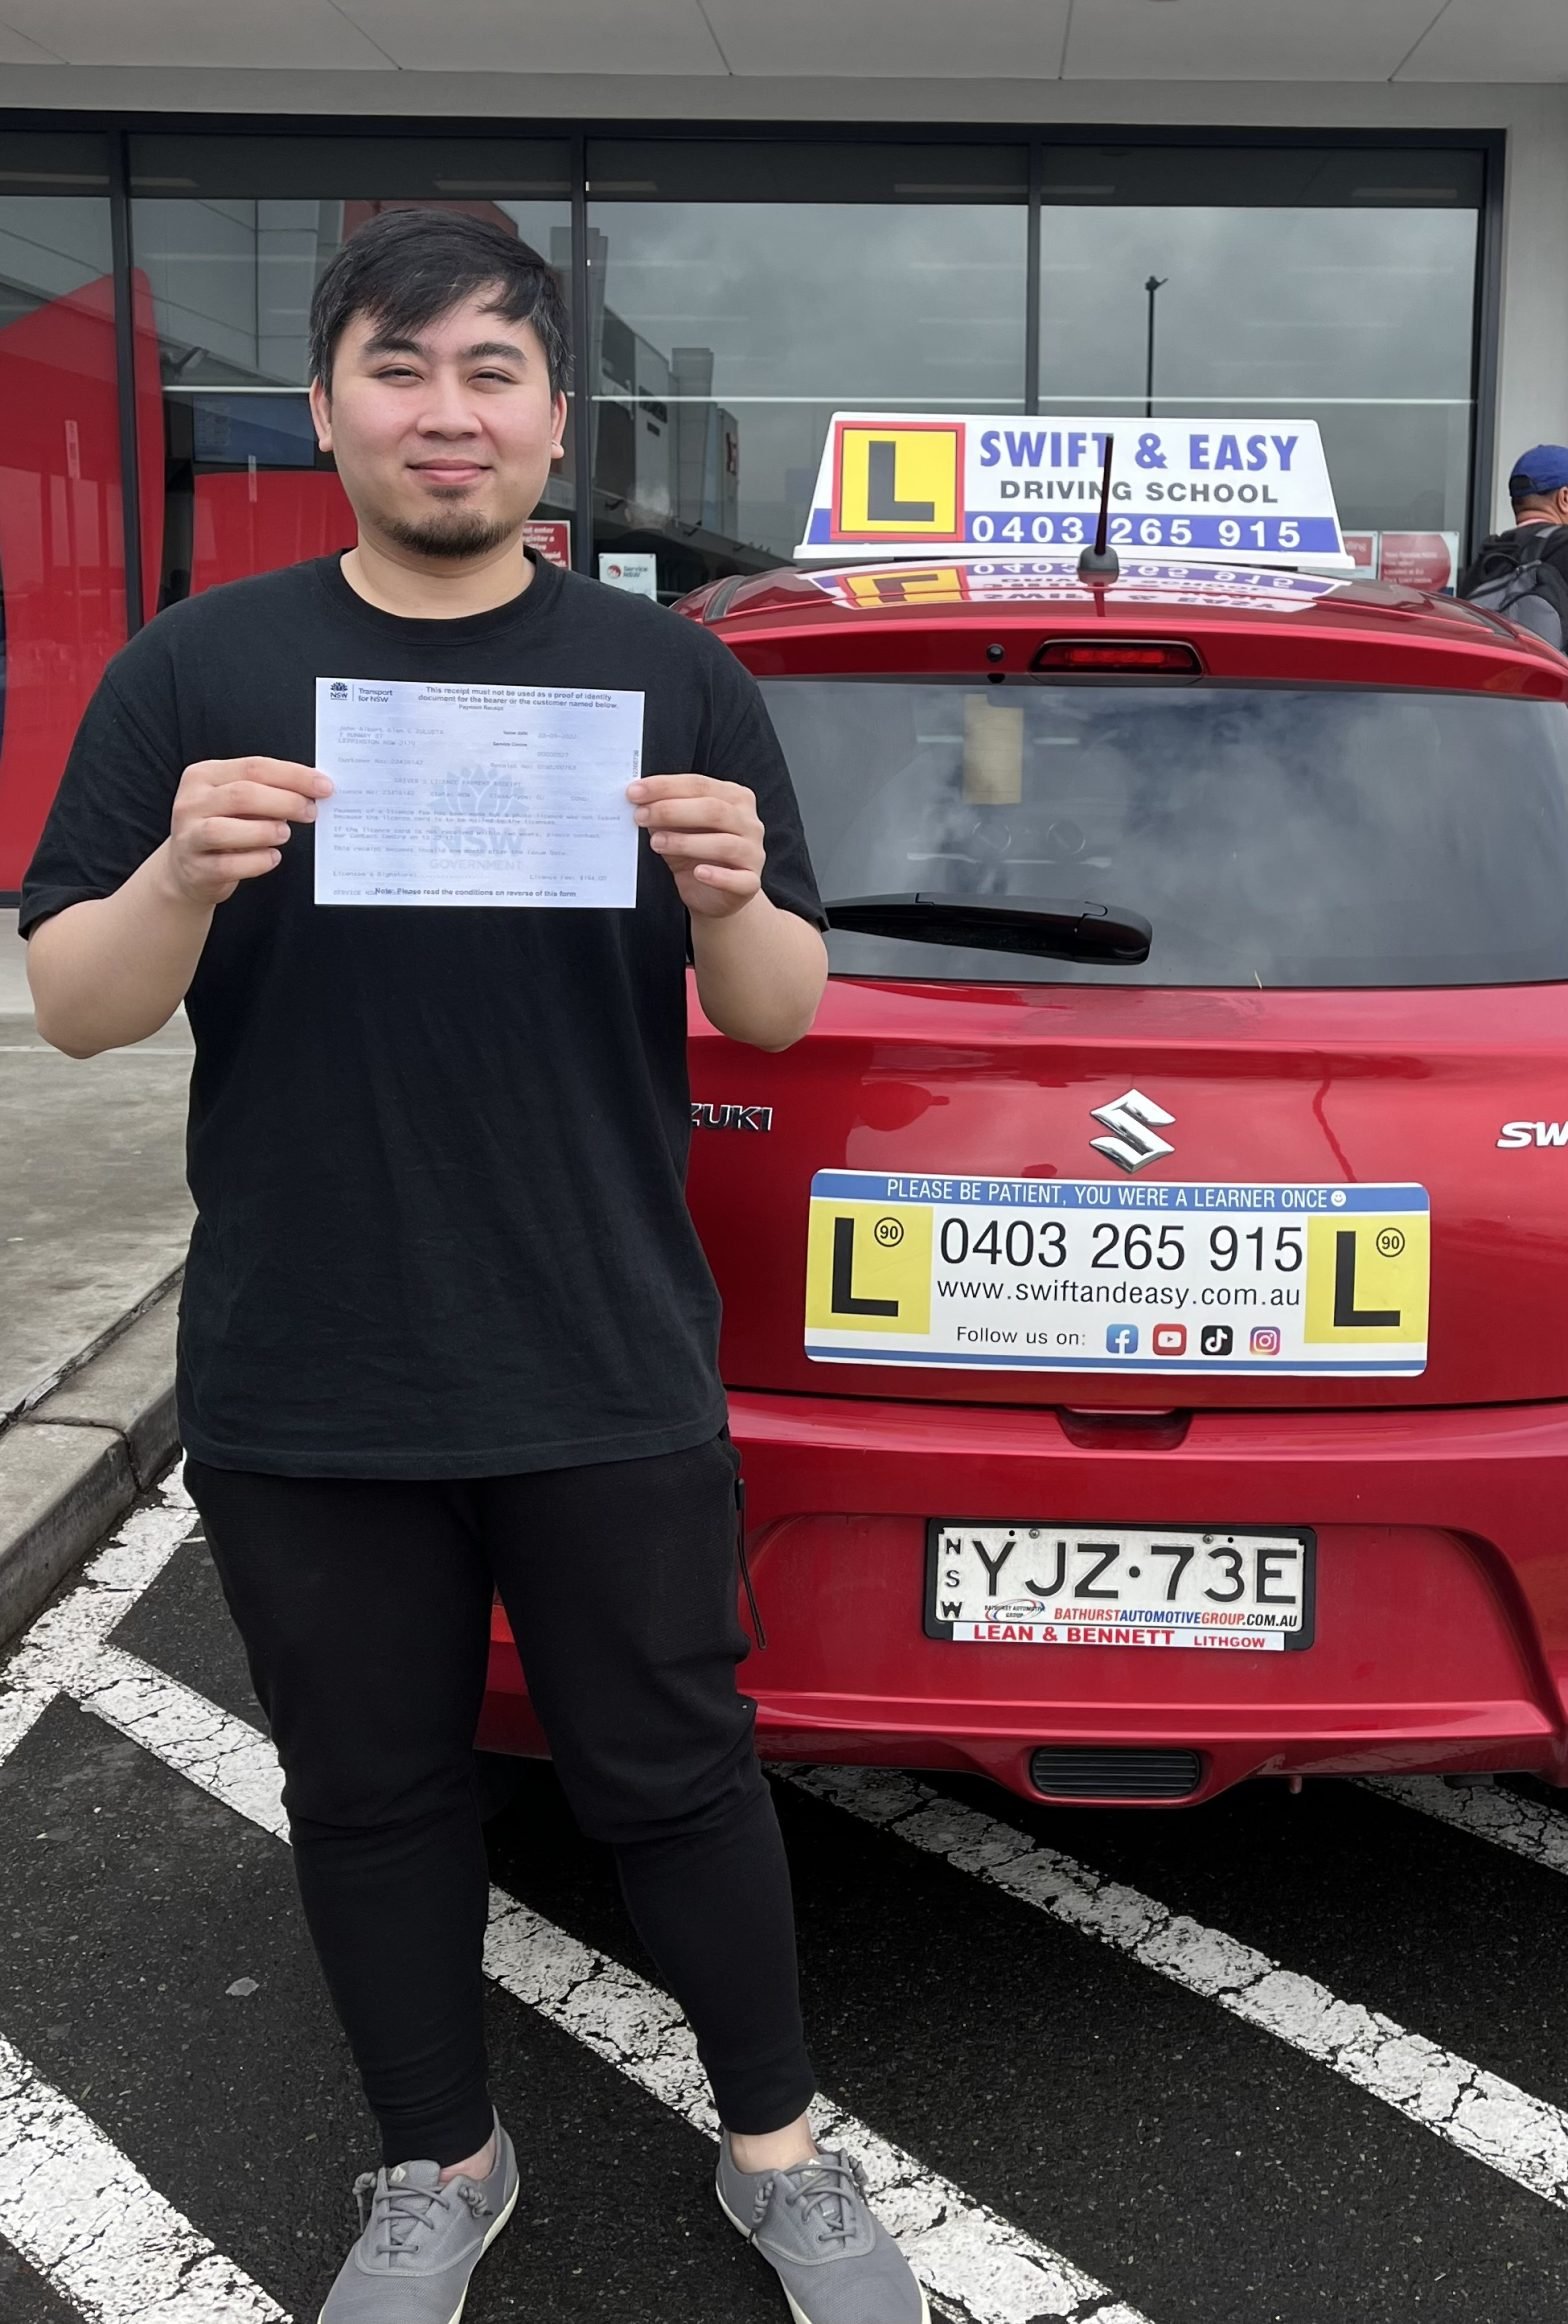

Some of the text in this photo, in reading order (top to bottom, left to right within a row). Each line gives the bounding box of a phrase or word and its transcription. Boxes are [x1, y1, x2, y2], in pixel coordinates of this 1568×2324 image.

[1134, 433, 1168, 470] &
[1190, 434, 1299, 472] EASY
[867, 440, 935, 522] L
[1000, 480, 1278, 504] DRIVING SCHOOL
[972, 517, 1301, 547] 0403 265 915
[358, 695, 368, 703] for
[359, 687, 393, 696] Transport
[418, 695, 456, 703] document
[458, 695, 469, 703] for
[483, 696, 507, 704] bearer
[519, 697, 531, 705] the
[568, 700, 594, 708] named
[426, 686, 442, 694] This
[444, 687, 470, 696] receipt
[471, 688, 490, 696] must
[492, 689, 505, 697] not
[506, 689, 516, 697] be
[517, 690, 535, 698] used
[554, 692, 574, 700] proof
[585, 693, 612, 702] identity
[441, 888, 453, 896] the
[454, 888, 494, 896] conditions
[535, 889, 543, 897] of
[887, 1179, 1328, 1209] PLEASE BE PATIENT, YOU WERE A LEARNER ONCE
[878, 1224, 900, 1241] 90
[1380, 1234, 1401, 1251] 90
[939, 1218, 1303, 1272] 0403 265 915
[831, 1217, 899, 1316] L
[1333, 1230, 1401, 1327] L
[937, 1278, 1301, 1310] www.swiftandeasy.com.au
[956, 1325, 1087, 1345] Follow us on:
[1054, 1607, 1298, 1628] BATHURSTAUTOMOTIVEGROUP.COM.AU
[974, 1624, 1266, 1648] LEAN & BENNETT LITHGOW
